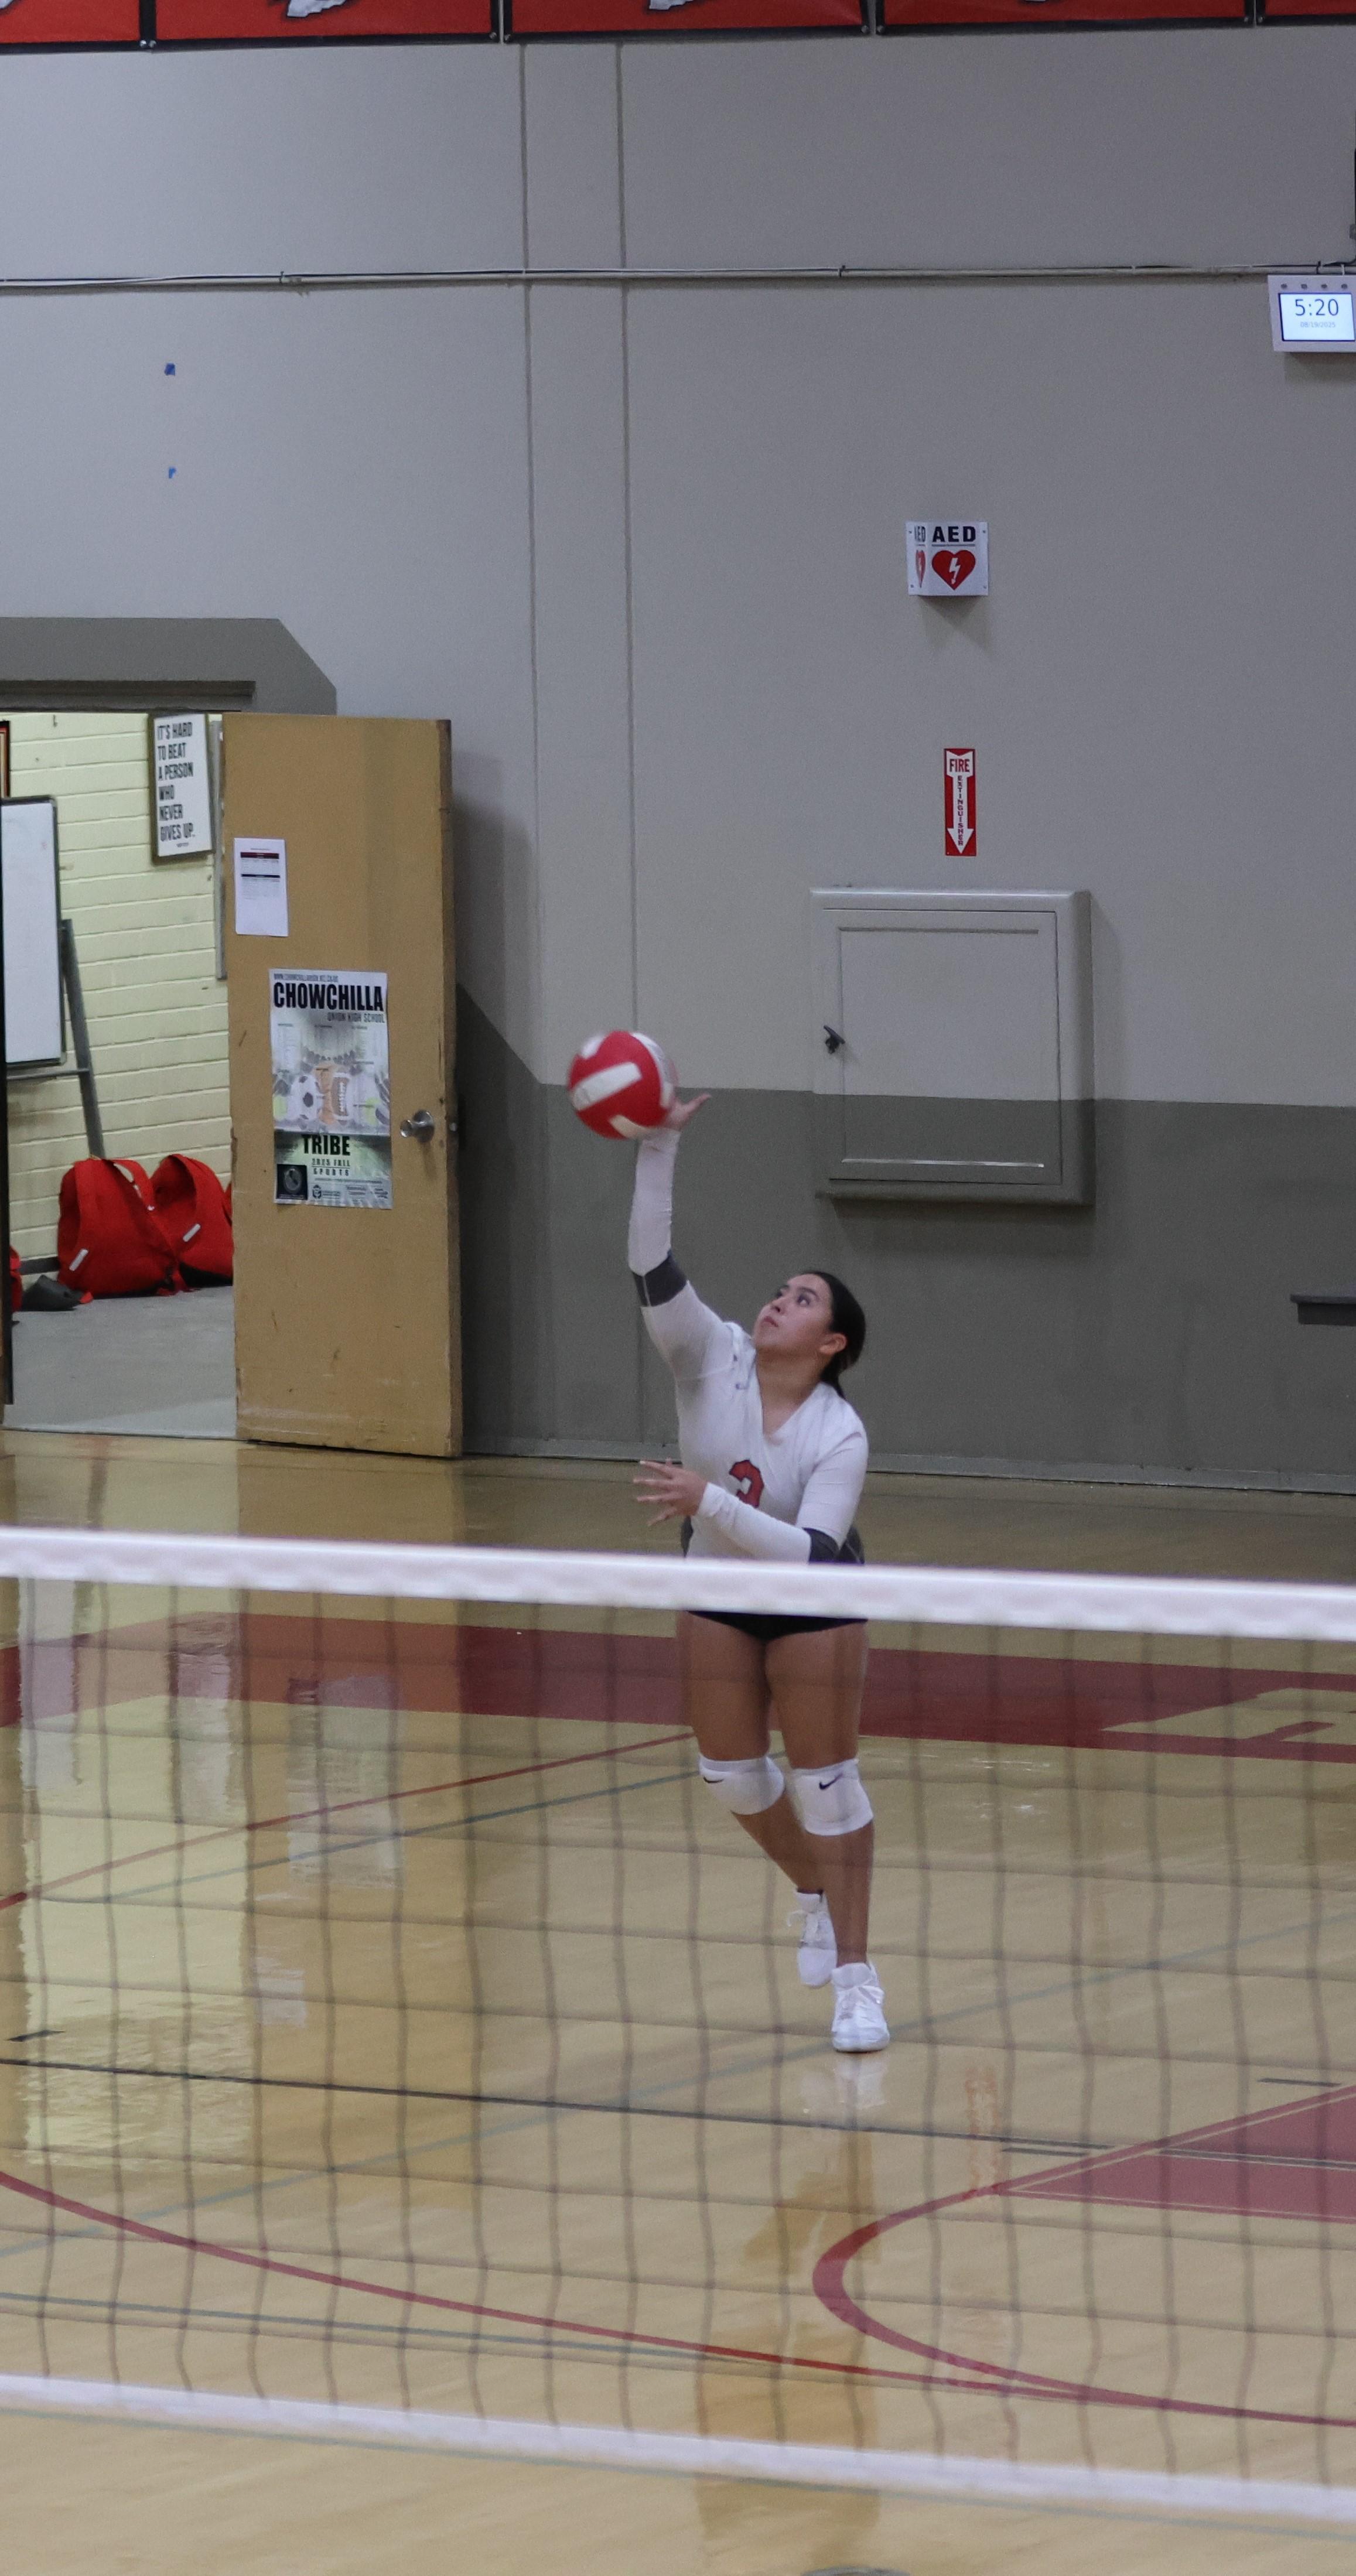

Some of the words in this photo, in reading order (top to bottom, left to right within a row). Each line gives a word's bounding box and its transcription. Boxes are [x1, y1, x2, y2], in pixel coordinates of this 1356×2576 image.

[1294, 298, 1339, 316] 5:20
[932, 526, 976, 542] AED
[157, 724, 170, 740] IT'S
[172, 722, 193, 739] HARD
[158, 746, 166, 761] TO
[168, 743, 186, 760] BEAT
[158, 766, 163, 781] A
[165, 762, 194, 780] PERSON
[949, 759, 970, 773] FIRE
[159, 784, 175, 801] WHO
[159, 804, 183, 821] NEVER
[160, 825, 181, 842] GIVES
[274, 982, 384, 1012] CHOWCHILLA
[364, 1013, 385, 1024] SCHOOL
[301, 1134, 351, 1156] TRIBE
[313, 1167, 350, 1177] SPORTS
